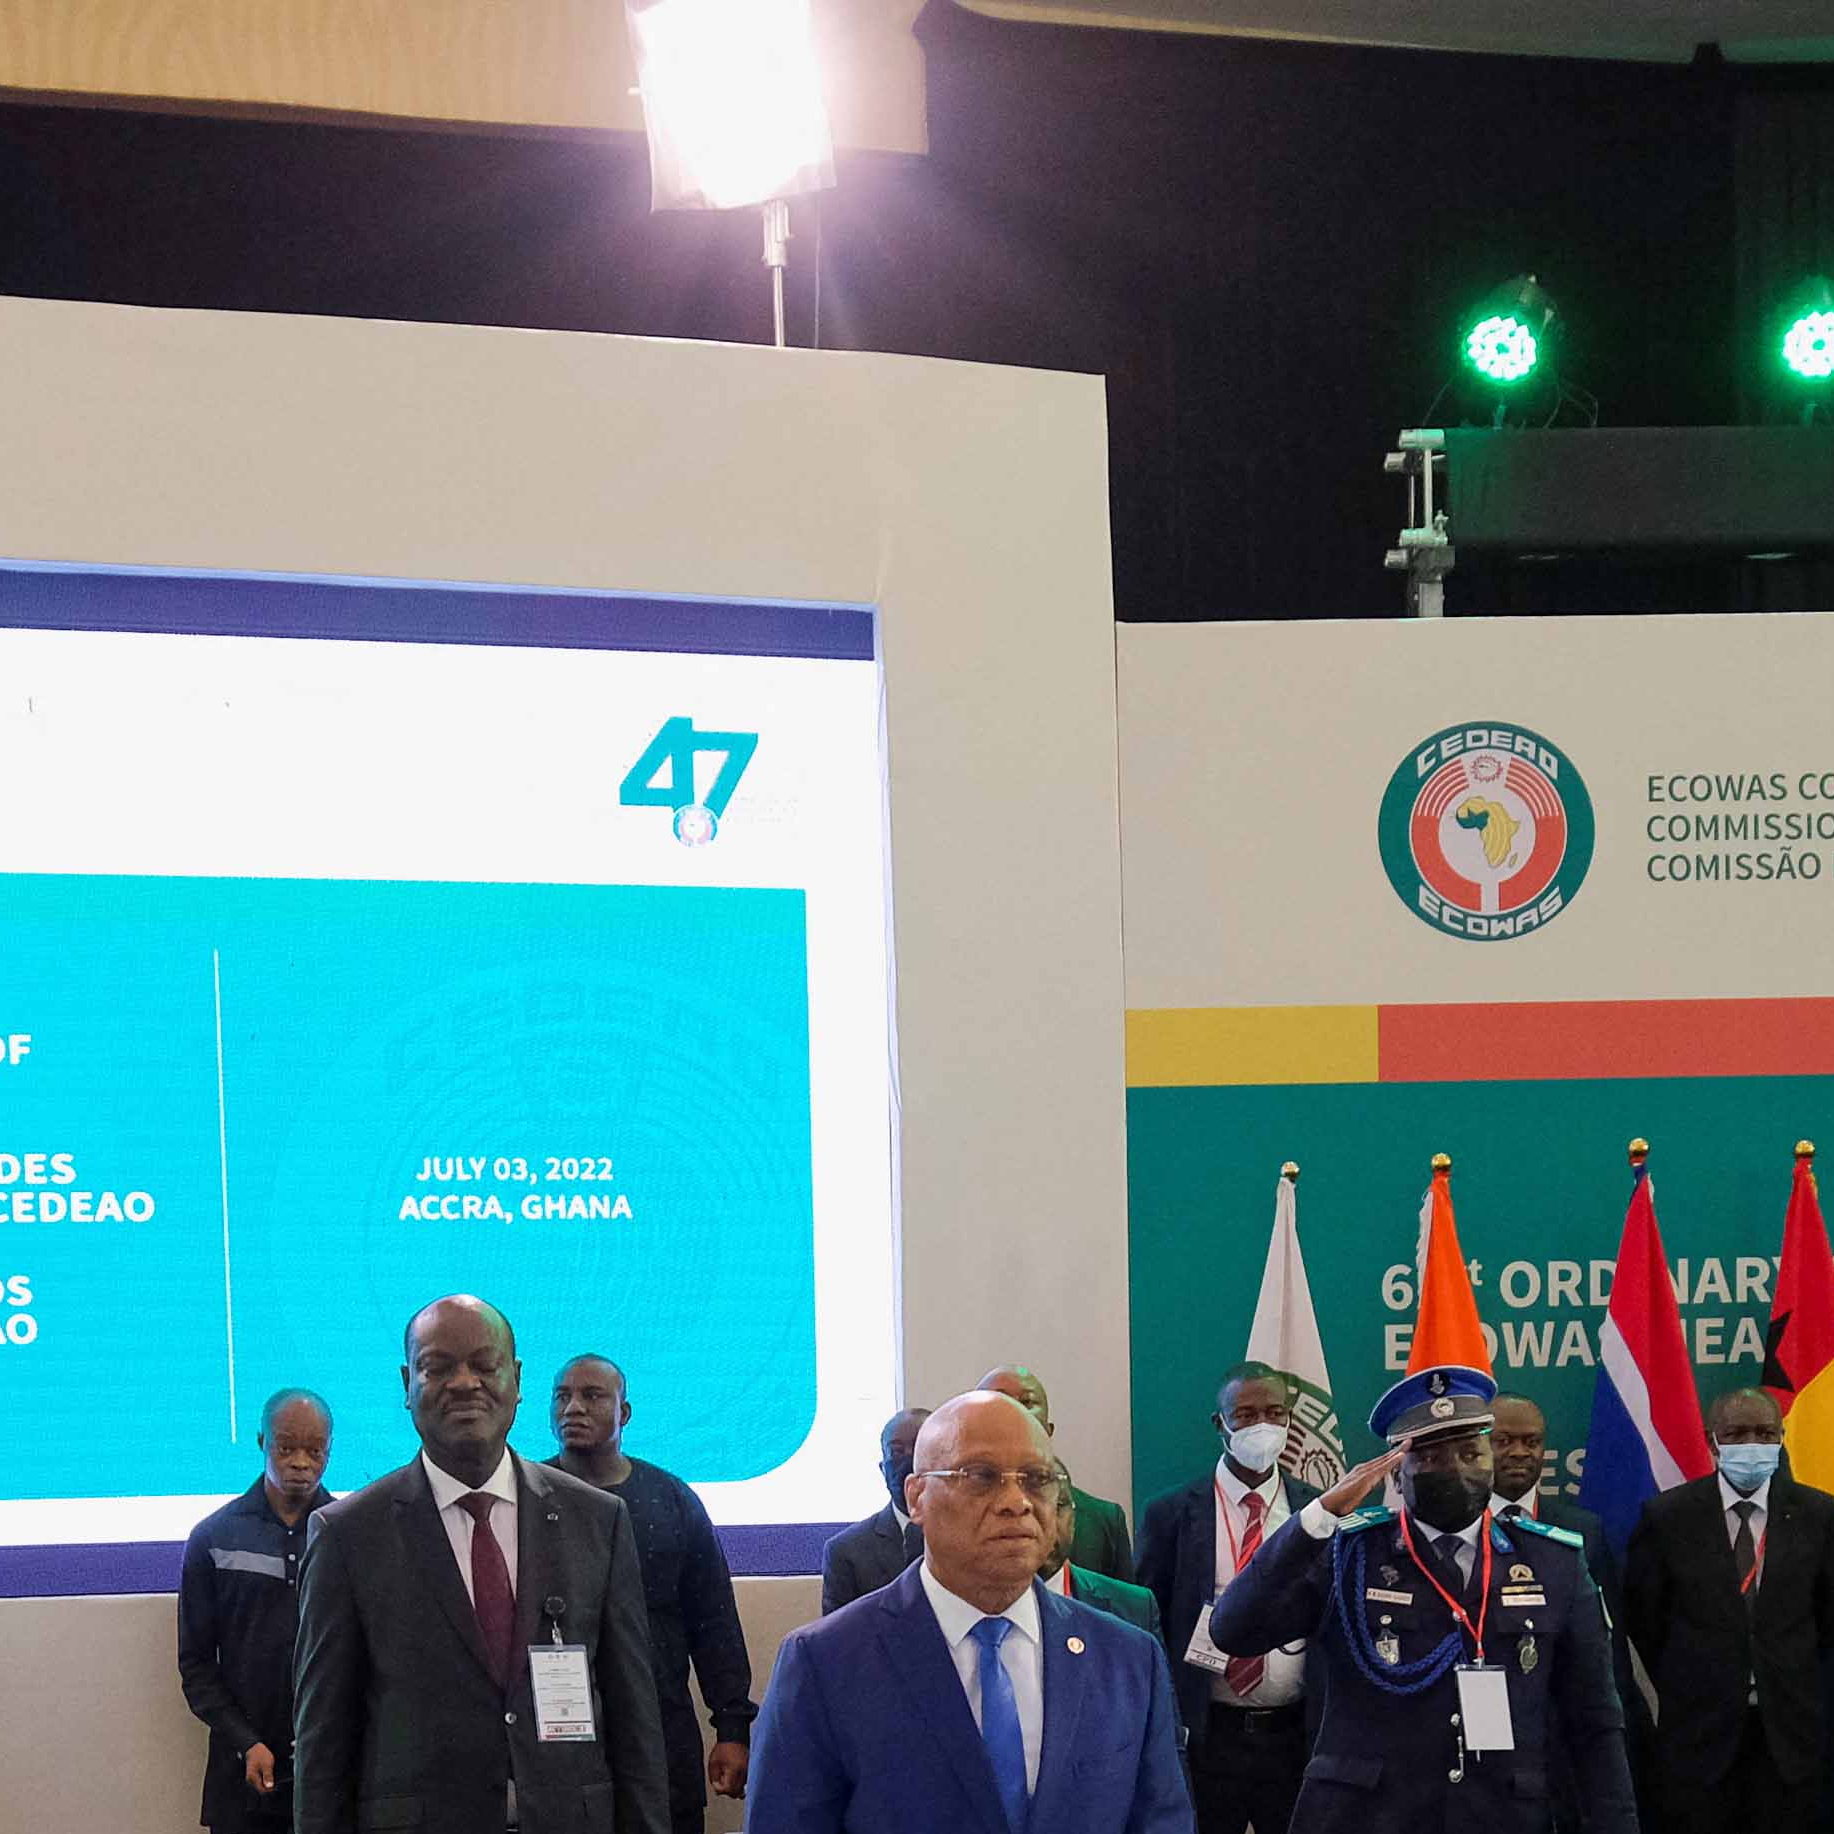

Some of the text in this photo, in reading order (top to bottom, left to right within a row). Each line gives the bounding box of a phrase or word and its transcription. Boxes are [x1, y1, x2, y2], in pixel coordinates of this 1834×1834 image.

[620, 717, 758, 820] 47
[1416, 729, 1560, 779] CEDEAO
[1648, 773, 1788, 803] ECOWAS
[1647, 846, 1820, 882] COMISSÃO
[1418, 885, 1564, 938] ECOWAS
[416, 1157, 613, 1184] JULY 03, 2022
[399, 1195, 634, 1224] ACCRA, GHANA
[1381, 1258, 1484, 1311] 6t
[1499, 1256, 1783, 1309] ORDNAR
